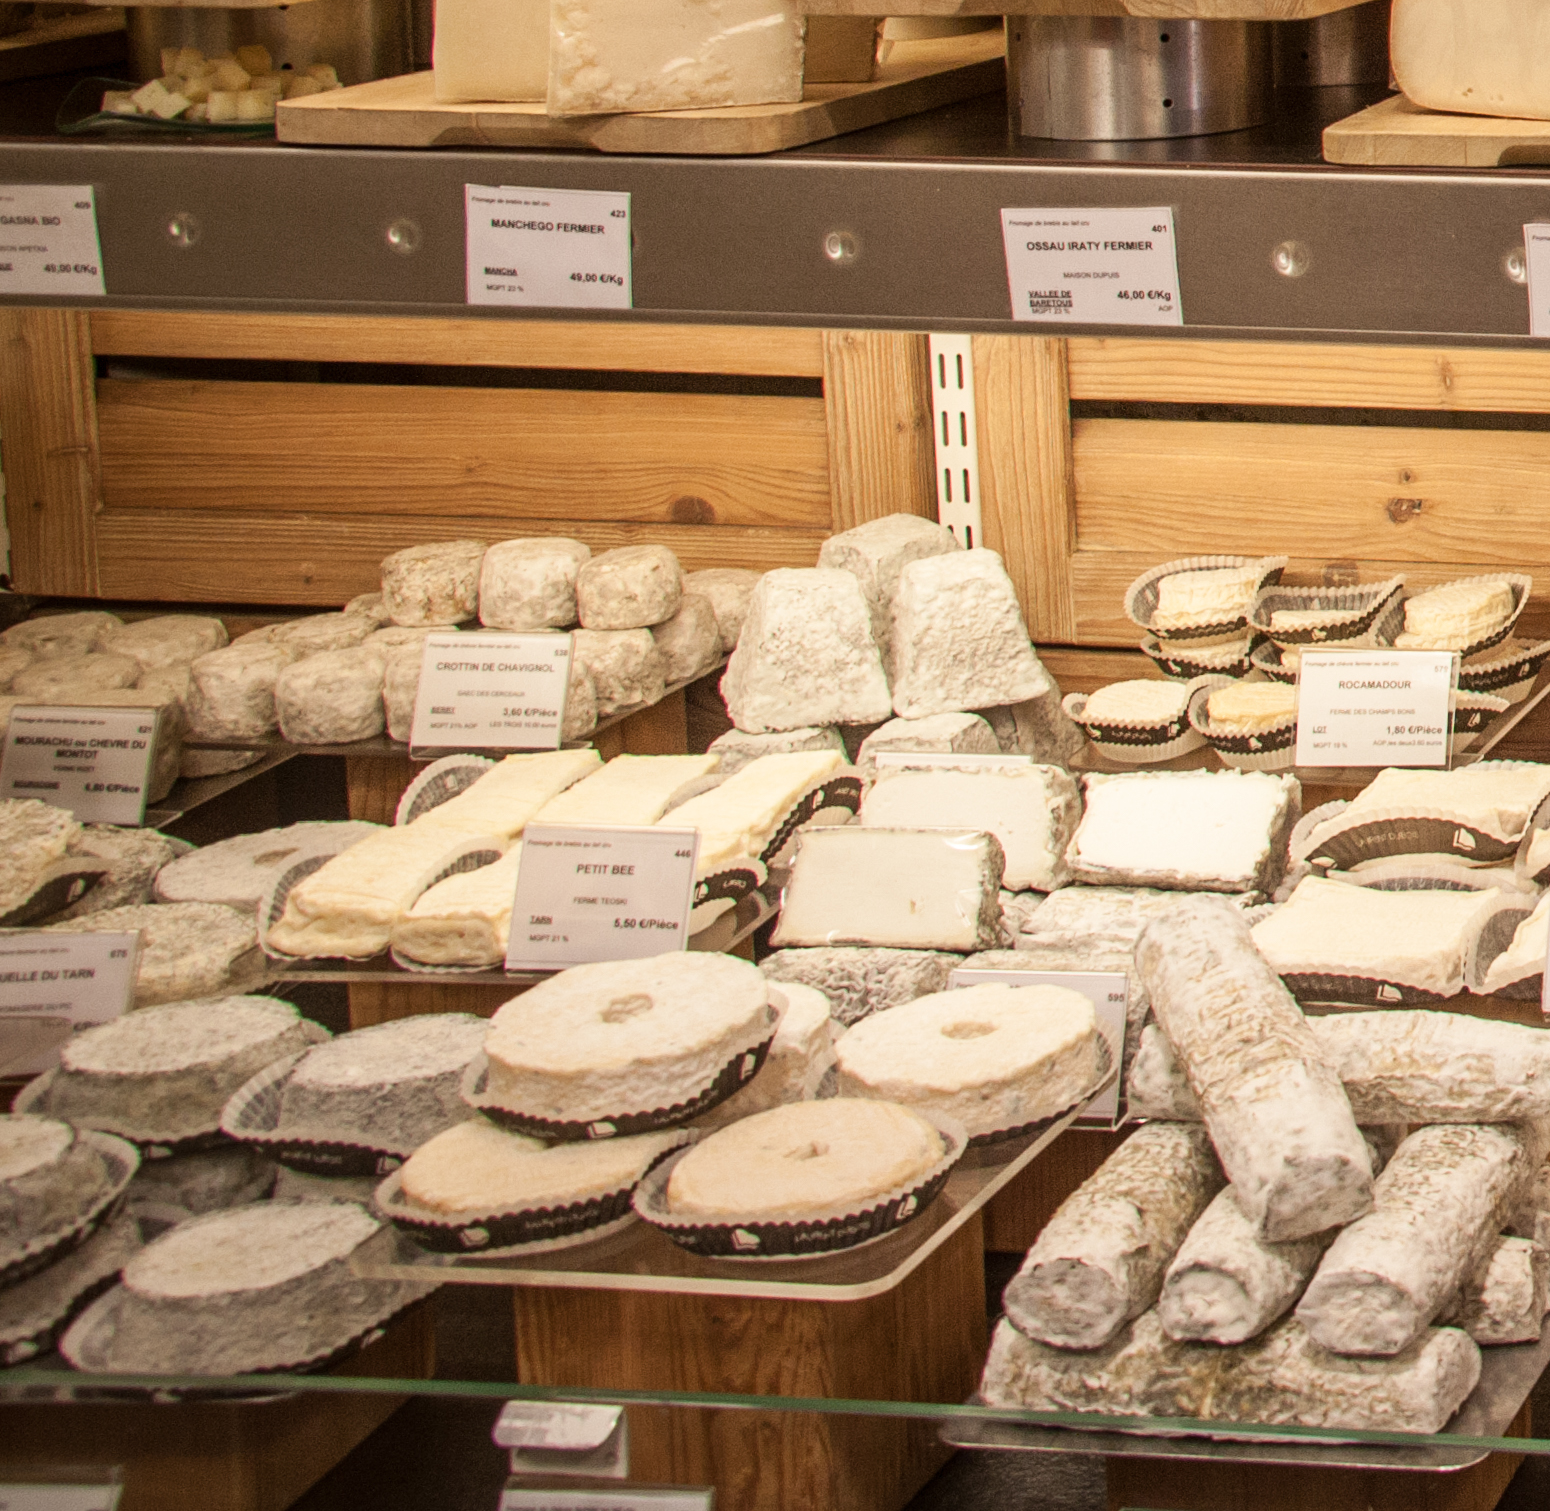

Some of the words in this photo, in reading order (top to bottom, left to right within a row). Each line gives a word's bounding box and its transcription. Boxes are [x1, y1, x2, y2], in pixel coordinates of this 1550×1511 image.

[611, 210, 626, 218] 423
[491, 219, 554, 231] MANCHEGO
[557, 223, 604, 233] FERMIER
[1027, 242, 1065, 250] OSSAU
[1068, 242, 1100, 250] IRATY
[1104, 242, 1152, 250] FERMIER
[436, 662, 479, 671] CROTTIN
[482, 663, 495, 671] DE
[498, 663, 555, 672] CHAVIGNOL
[1339, 681, 1411, 689] ROCAMADOUR
[1387, 726, 1405, 735] 1,80
[1409, 726, 1442, 734] €/Pièce
[577, 864, 608, 874] PETIT
[612, 865, 635, 875] BEE
[614, 918, 636, 928] 5,50
[639, 918, 678, 929] €/Pièce
